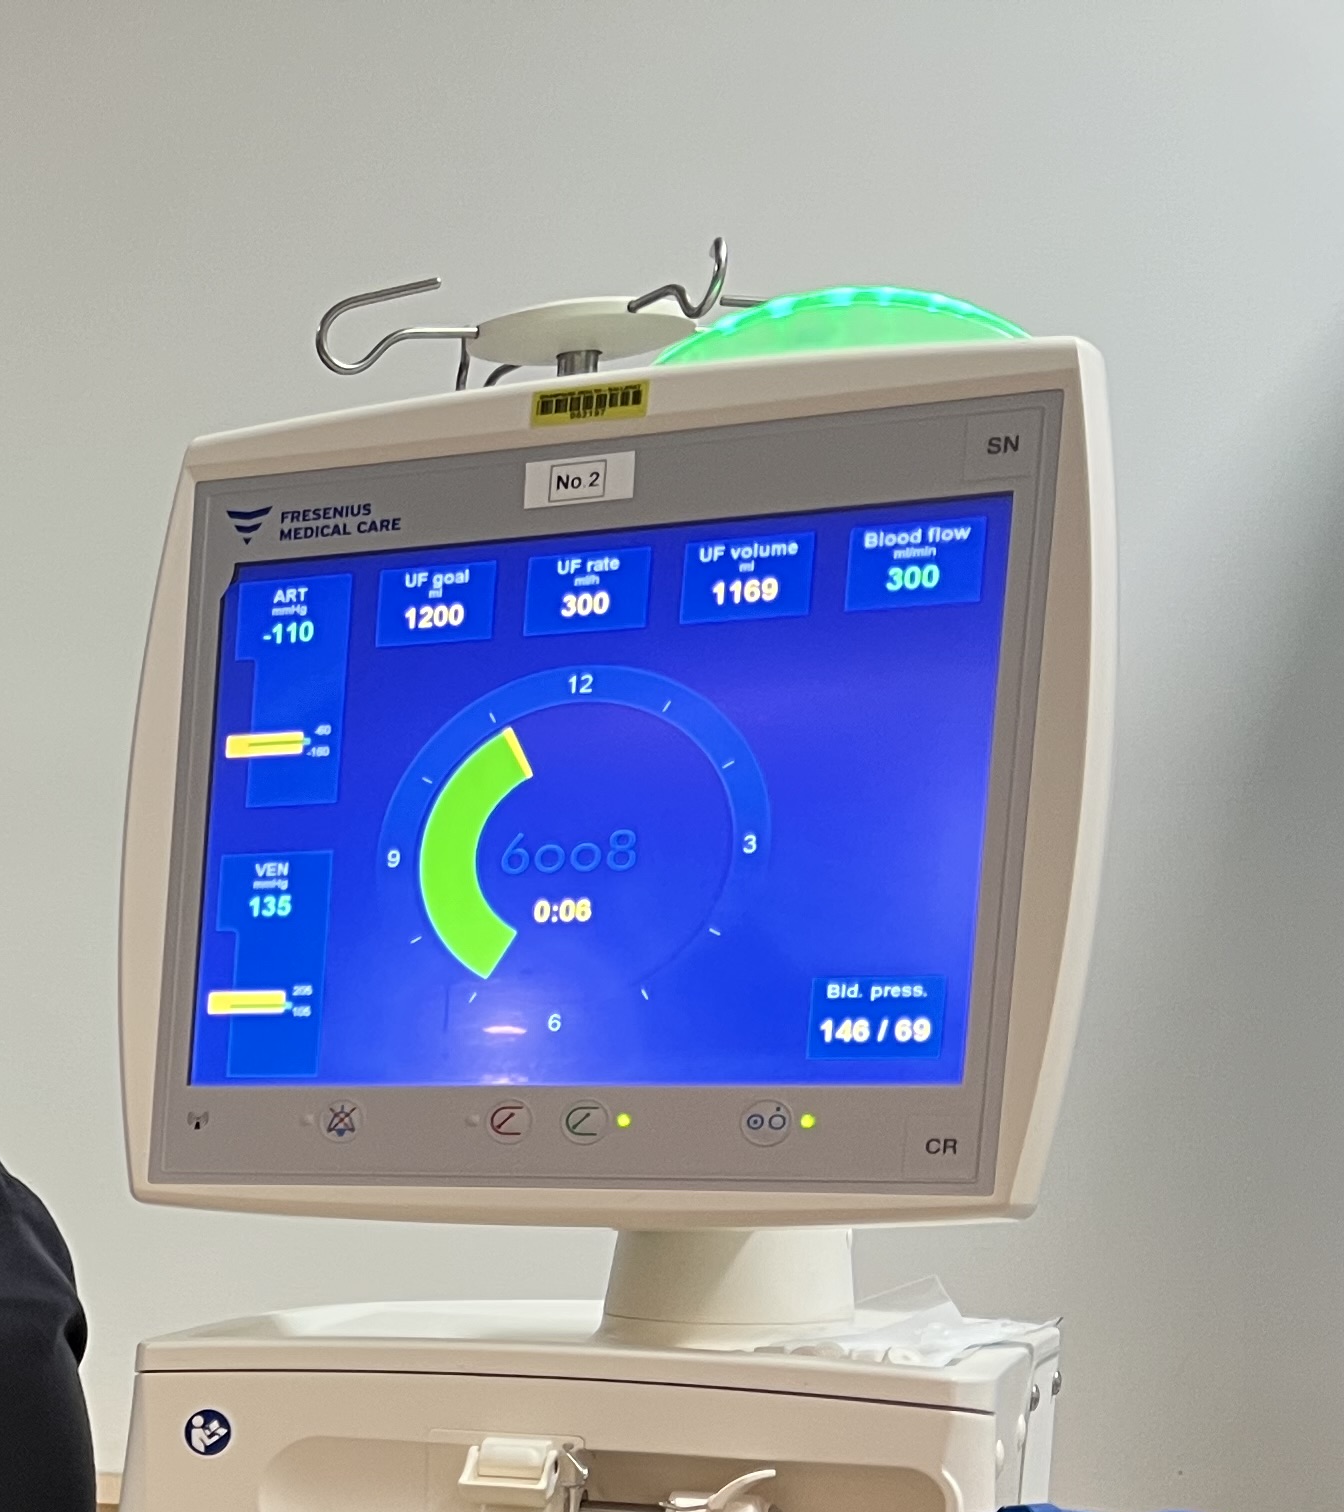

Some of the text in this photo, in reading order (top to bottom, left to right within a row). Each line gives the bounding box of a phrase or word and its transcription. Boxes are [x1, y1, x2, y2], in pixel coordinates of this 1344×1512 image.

[987, 435, 1019, 455] SN
[280, 503, 372, 524] FRESENIUS
[279, 517, 401, 541] MEDICAL CARE
[864, 526, 972, 549] Blood flow
[699, 540, 799, 562] UF volume
[557, 557, 620, 575] UF rate
[405, 569, 469, 589] UF goal
[885, 564, 940, 591] 300
[273, 587, 308, 603] ART
[713, 577, 779, 605] 1169
[561, 592, 610, 618] 300
[405, 604, 464, 629] 1200
[263, 620, 314, 644] -110
[568, 674, 594, 694] 12
[742, 834, 757, 854] 3
[387, 850, 401, 868] 9
[255, 862, 289, 877] VEN
[248, 895, 292, 918] 135
[826, 983, 928, 1001] Bld. press.
[547, 1014, 561, 1032] 6
[820, 1018, 870, 1043] 146
[894, 1017, 932, 1043] 69
[925, 1138, 958, 1155] CR
